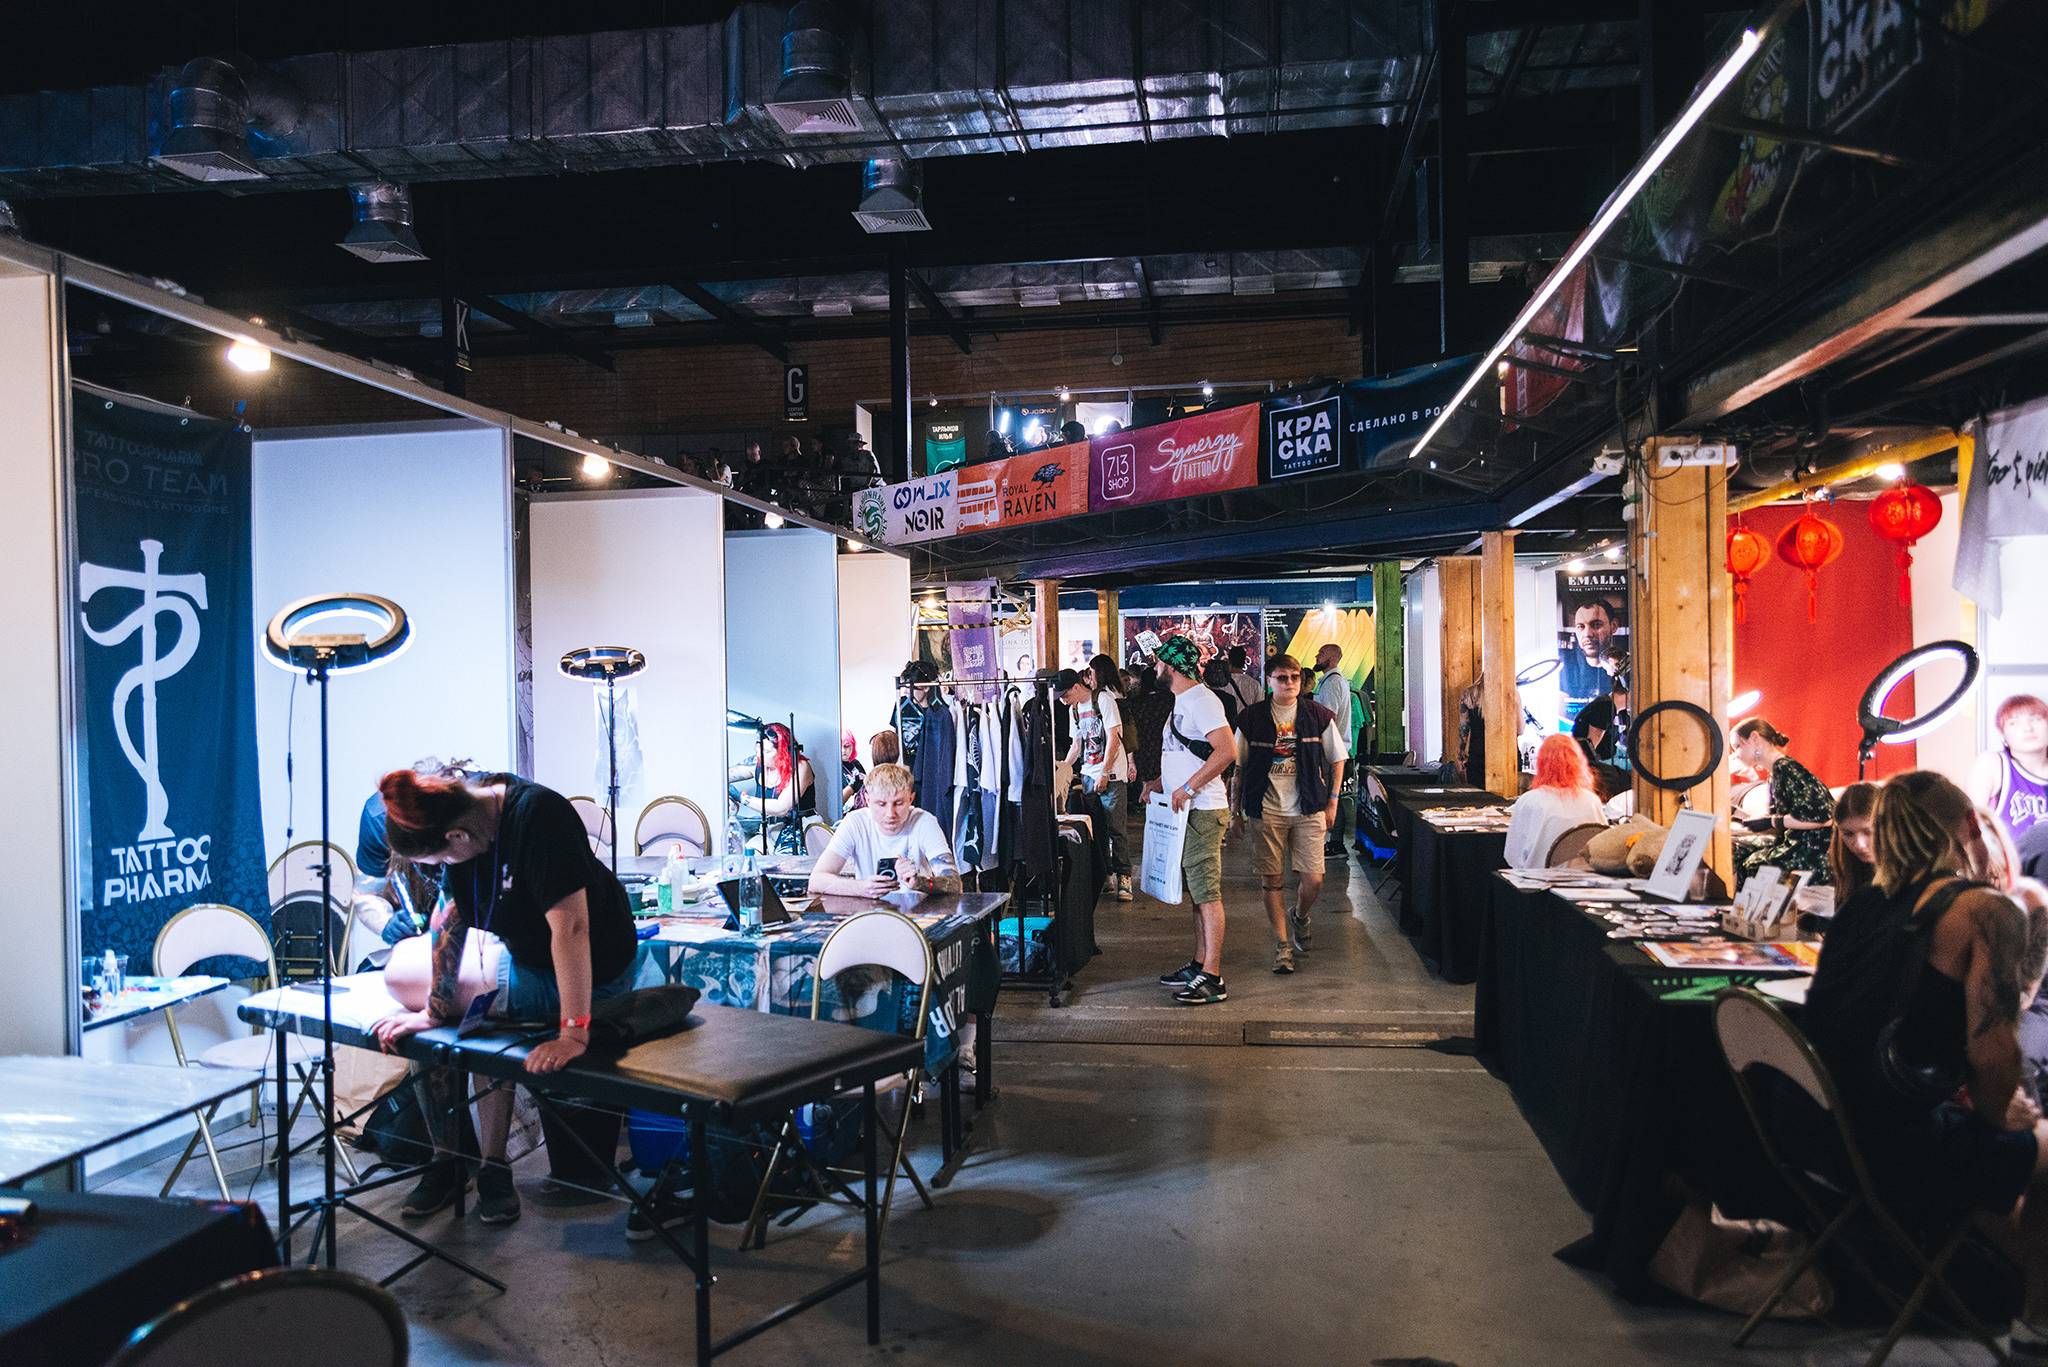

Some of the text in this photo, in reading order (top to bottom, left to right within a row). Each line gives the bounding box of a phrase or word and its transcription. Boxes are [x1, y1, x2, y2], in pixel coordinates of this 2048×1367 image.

[787, 367, 804, 404] G
[931, 425, 959, 433] ТАРЛЫКОВ
[1277, 411, 1332, 440] КРА
[1350, 414, 1406, 432] СДЕЛАНО
[1412, 411, 1419, 421] В
[938, 432, 953, 440] ИЛЬЯ
[1278, 432, 1332, 460] СКА
[1107, 454, 1129, 478] 7.13
[1150, 432, 1243, 484] Synergy
[1183, 460, 1212, 480] TATTOO
[1283, 459, 1312, 470] TATTOO
[142, 464, 229, 497] TEAM
[1003, 484, 1029, 498] ROYAL
[1108, 477, 1129, 491] SHOP
[1003, 491, 1057, 519] RAVEN
[904, 507, 945, 535] NOIR
[1568, 575, 1627, 586] EMALLA
[110, 834, 211, 875] TATTOO
